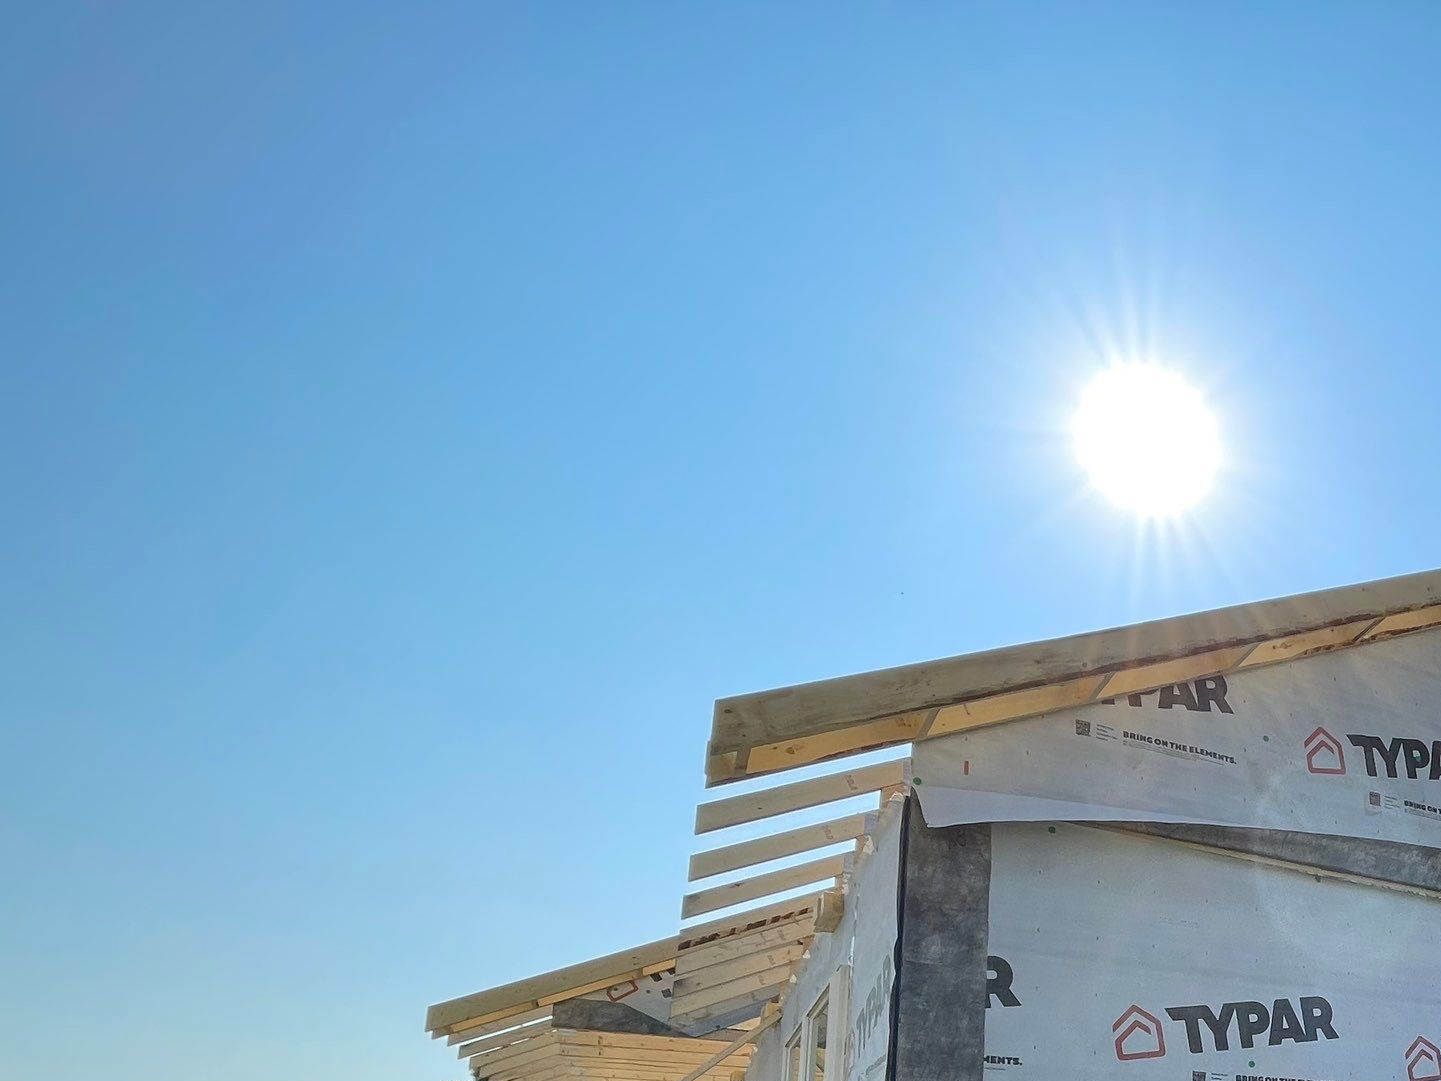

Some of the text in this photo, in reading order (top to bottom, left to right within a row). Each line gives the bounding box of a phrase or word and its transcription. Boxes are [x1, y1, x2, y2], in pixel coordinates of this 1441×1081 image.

[1122, 730, 1153, 744] BRING
[1154, 738, 1168, 748] ON
[1169, 741, 1188, 752] THE
[1189, 746, 1237, 765] ELEMENTS.
[1164, 996, 1340, 1053] TYPAR
[984, 1055, 1022, 1065] MENTS.
